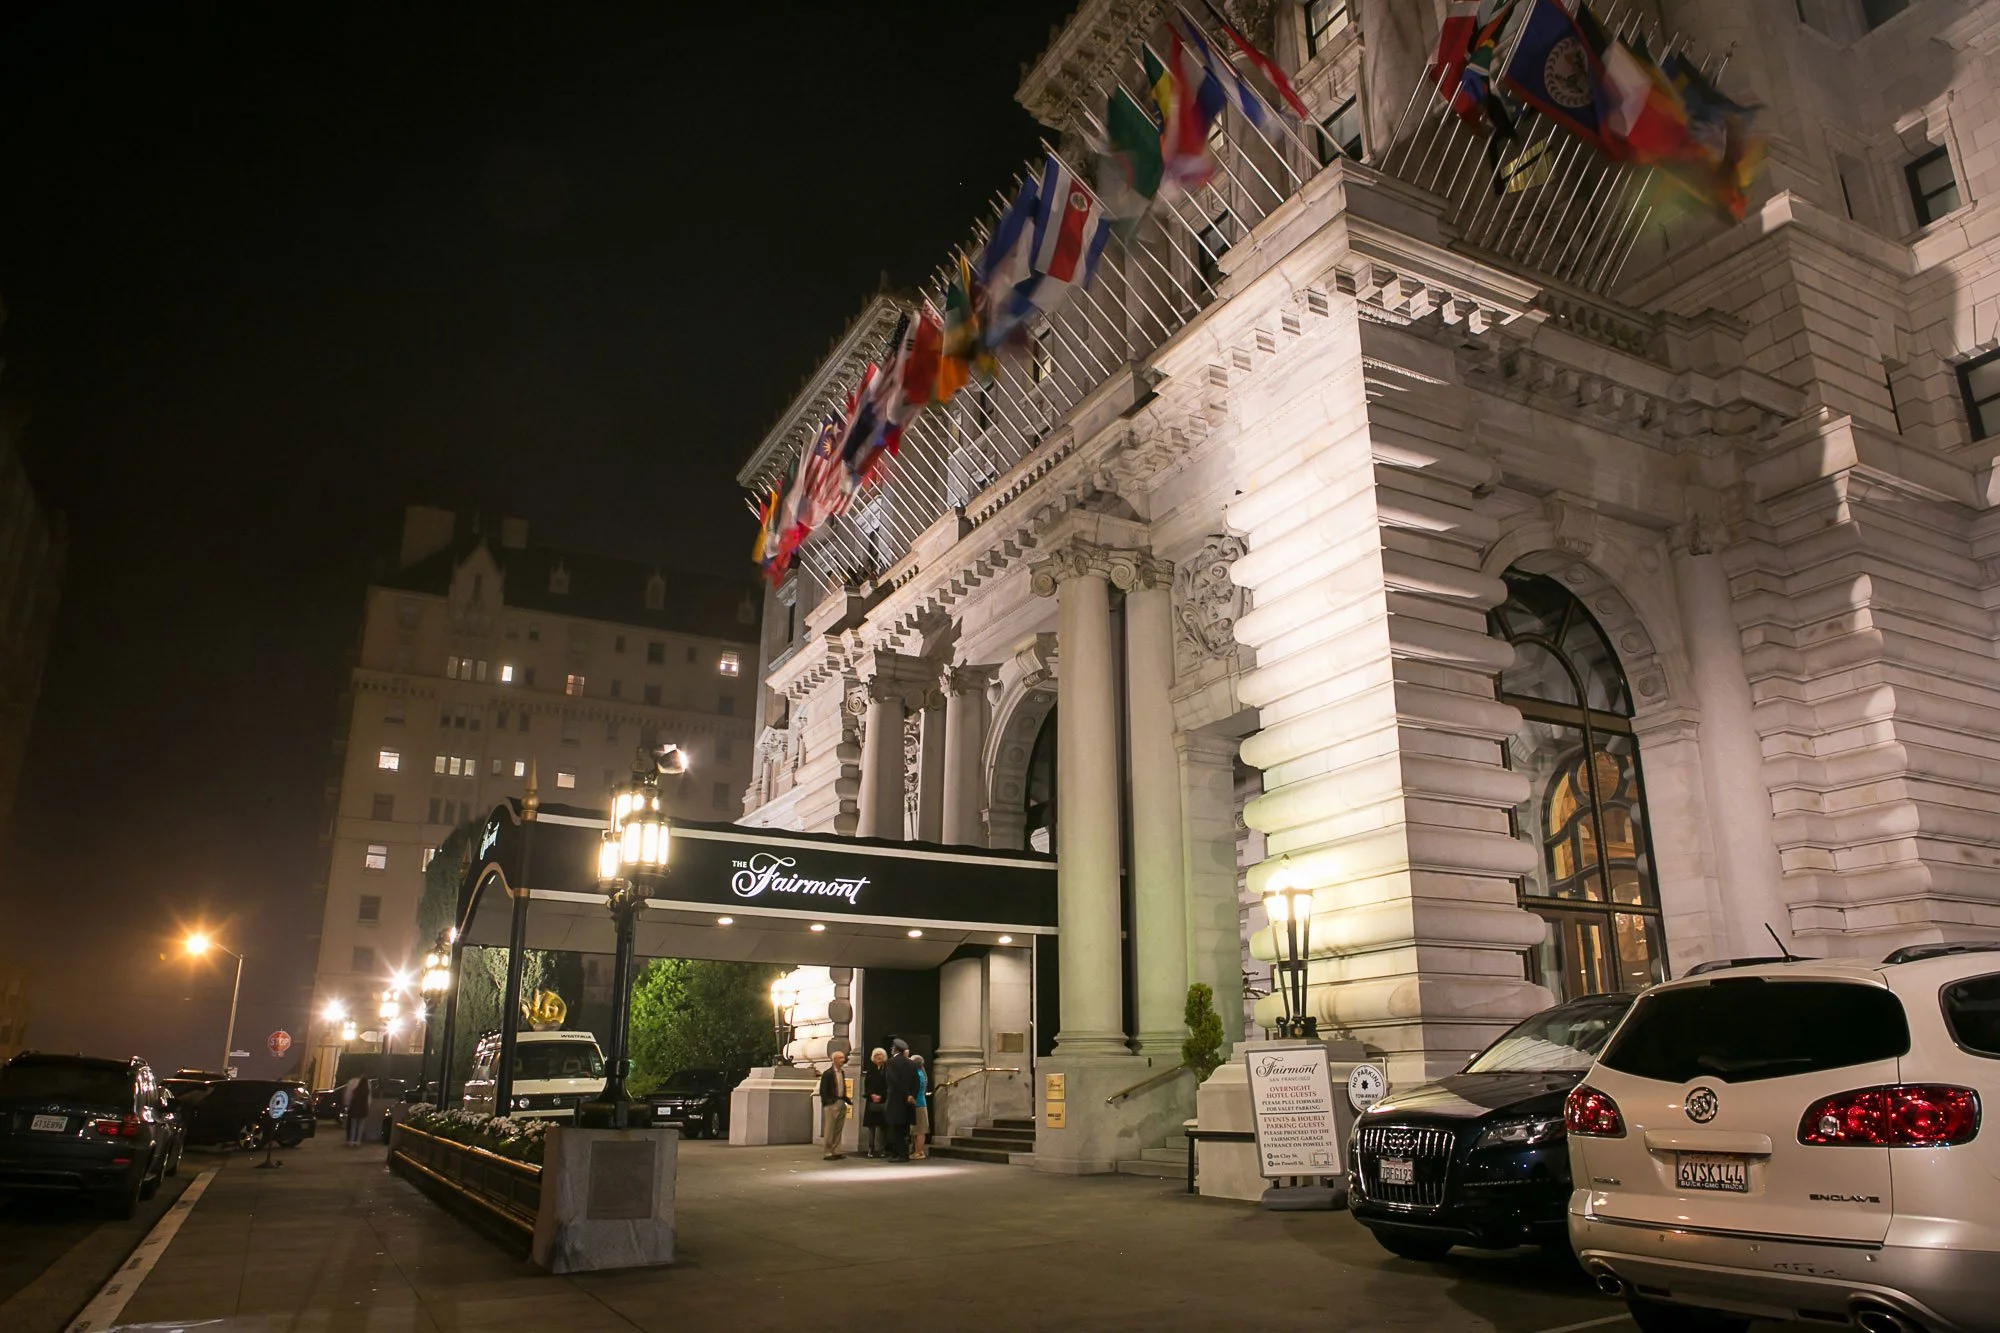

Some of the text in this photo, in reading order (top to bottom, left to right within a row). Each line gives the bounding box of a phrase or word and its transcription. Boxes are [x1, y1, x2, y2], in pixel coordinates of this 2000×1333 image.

[732, 852, 871, 905] THE Fairmont
[270, 1037, 290, 1046] STOP
[1256, 1056, 1318, 1078] Fairmont
[1352, 1069, 1381, 1088] NO PARKING
[1269, 1085, 1311, 1093] OVERNIGHT
[1681, 1162, 1743, 1183] 6VSK144
[1809, 1193, 1881, 1203] ENCLAVE
